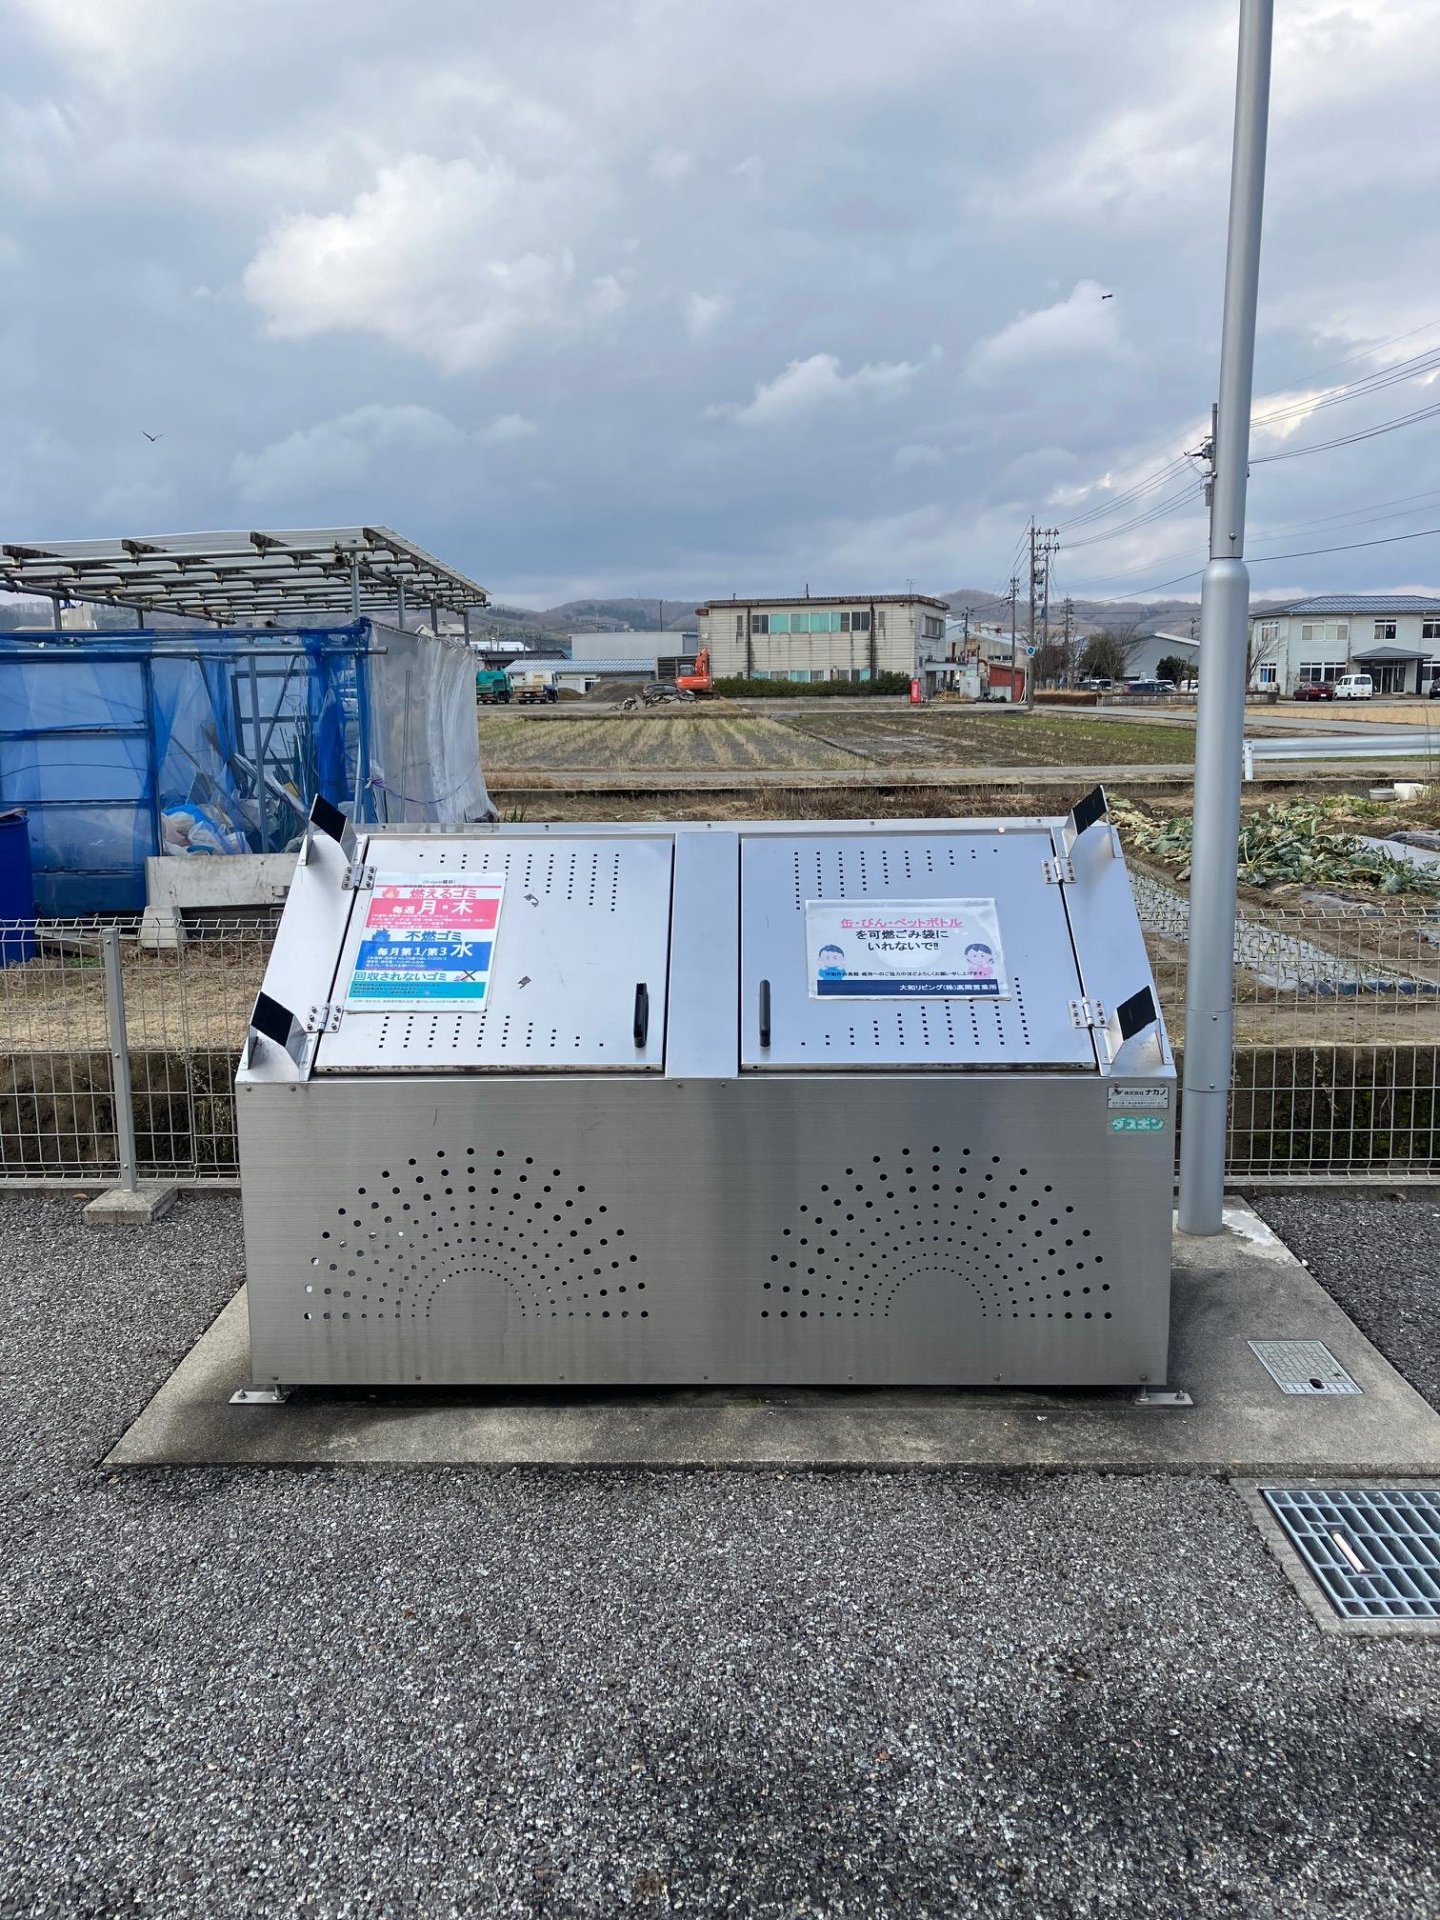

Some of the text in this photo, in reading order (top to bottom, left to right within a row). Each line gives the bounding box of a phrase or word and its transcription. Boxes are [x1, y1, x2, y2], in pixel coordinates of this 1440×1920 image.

[410, 888, 477, 899] 燃えるゴミ
[404, 931, 462, 942] 不燃ゴミ
[856, 930, 949, 940] を可燃ごみ袋に
[353, 971, 447, 981] 回収されないゴミ
